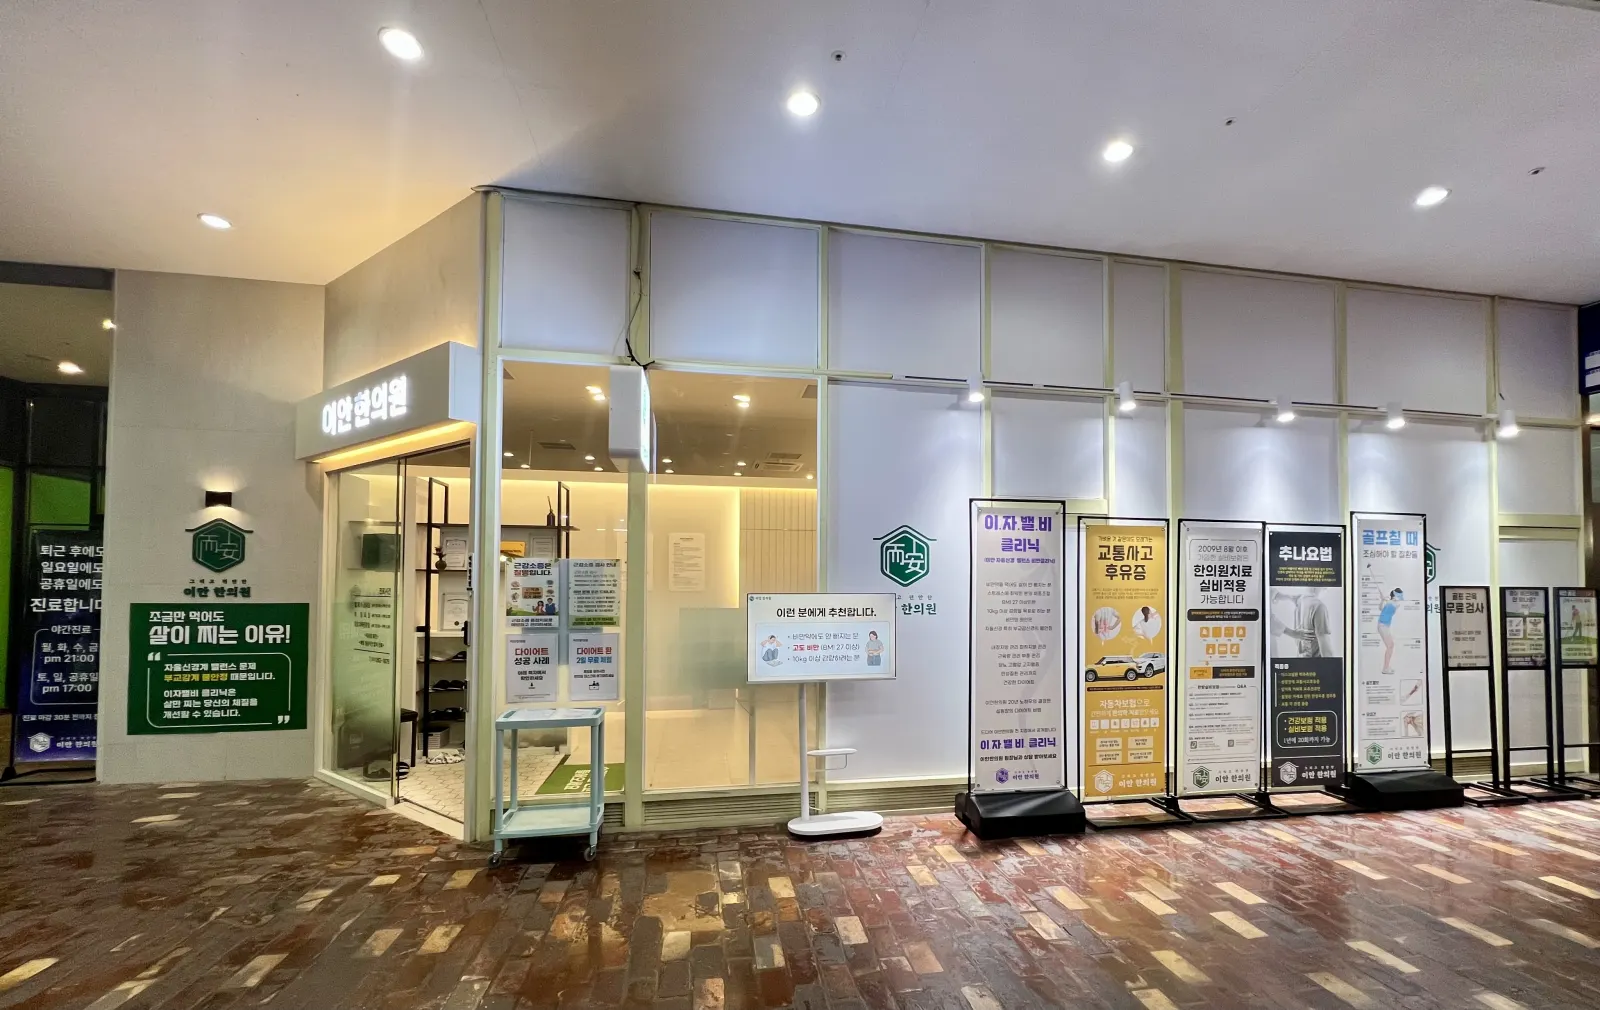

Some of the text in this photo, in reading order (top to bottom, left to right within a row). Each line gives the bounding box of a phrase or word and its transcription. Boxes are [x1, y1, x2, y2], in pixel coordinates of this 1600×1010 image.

[322, 375, 407, 435] 이안 한의원
[1363, 530, 1418, 546] 골프칠 때
[1001, 538, 1040, 552] 클리닉
[1198, 545, 1222, 553] 2009년
[1224, 545, 1234, 553] 8월
[40, 545, 104, 557] 퇴근 후에도
[1098, 545, 1153, 561] 교통사고
[1279, 545, 1332, 562] 추나요법
[1363, 550, 1389, 558] 조심해야
[41, 562, 103, 574] 일요일에도
[1105, 564, 1146, 580] 후유증
[1194, 564, 1253, 577] 한의원치료
[40, 578, 102, 590] 공휴일에도
[1200, 580, 1246, 593] 실비적용
[183, 587, 251, 598] 이안 한의원
[1201, 595, 1244, 604] 가능합니다
[776, 607, 877, 618] 이런 분에게 추천합니다.
[901, 603, 936, 615] 한의원
[1446, 603, 1484, 614] 무료 검사
[149, 611, 225, 622] 조금만 먹어도
[51, 625, 92, 635] 야간진료
[149, 624, 291, 645] 살이 찌는 이유!
[57, 643, 70, 653] 화,
[72, 643, 86, 653] 수,
[515, 648, 549, 656] 다이어트
[577, 647, 604, 655] 다이어트
[792, 644, 805, 652] 고도
[807, 644, 819, 652] 비만
[846, 643, 860, 651] 이상)
[44, 654, 94, 664] pm 21:00
[514, 656, 550, 665] 성공 사례
[164, 662, 256, 672] 자율신경계 밸런스 문제
[37, 673, 98, 683] 토, 일, 공휴일
[230, 672, 275, 681] 때문입니다.
[42, 684, 92, 694] pm 17:00
[202, 688, 236, 697] 클리닉은
[183, 700, 201, 708] 찌는
[203, 699, 230, 708] 당신의
[232, 698, 258, 707] 체질을
[1099, 699, 1150, 709] 자동차보험으로
[192, 710, 201, 718] 수
[203, 709, 241, 718] 있습니다.
[1029, 737, 1056, 748] 클리닉
[1388, 751, 1421, 760] 이안 한의원
[1231, 774, 1251, 782] 한의원
[1302, 771, 1315, 779] 이안
[1119, 778, 1157, 788] 이안 한의원
